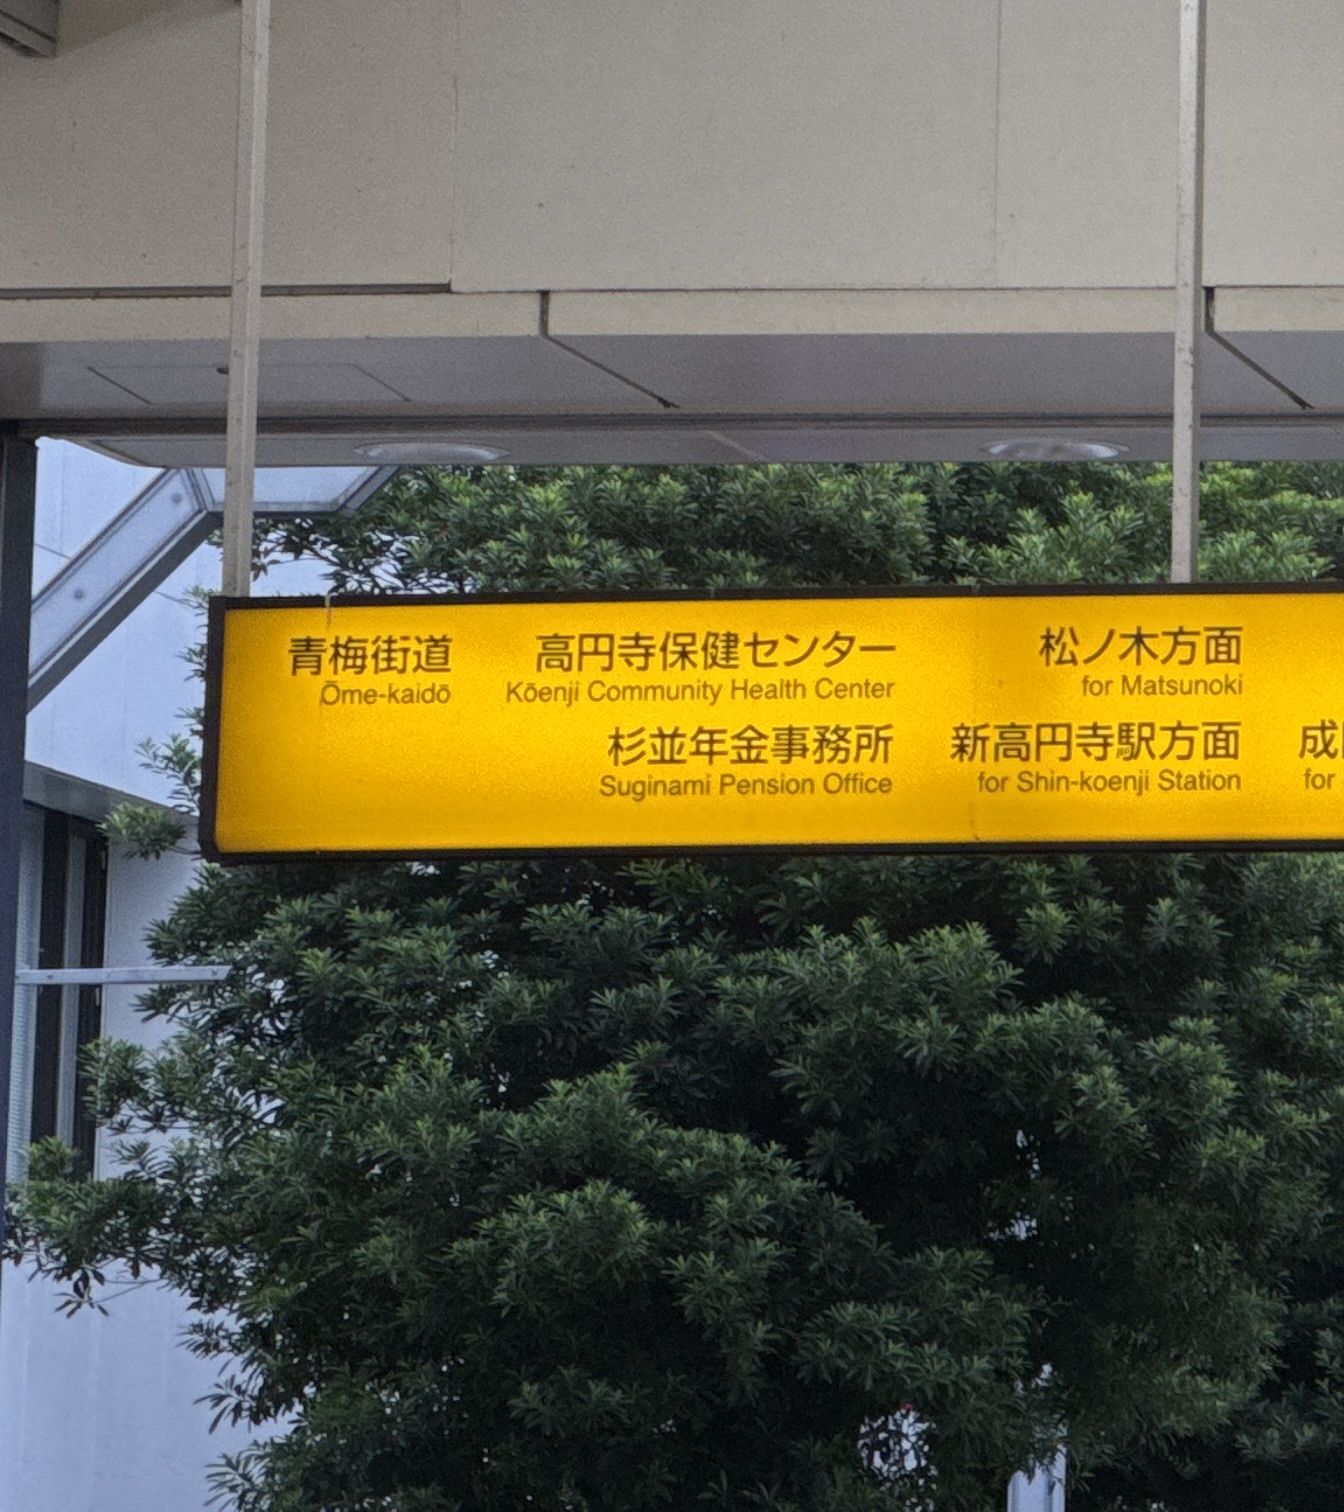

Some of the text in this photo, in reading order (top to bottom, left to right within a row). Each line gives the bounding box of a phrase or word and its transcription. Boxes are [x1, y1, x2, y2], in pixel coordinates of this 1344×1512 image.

[289, 635, 452, 676] 青梅街道
[537, 631, 895, 672] 高円寺保健センター
[1039, 626, 1242, 666] 松ノ木方面
[318, 680, 451, 706] Ōme-kaidō
[507, 677, 895, 707] Kōenji Community Health Center
[1082, 674, 1242, 696] for Matsunoki
[609, 725, 892, 765] 杉並年金事務所
[951, 721, 1240, 762] 新高円寺駅方面
[599, 772, 892, 803] Suginami Pension Office
[978, 769, 1241, 796] for Shin-koenji Station
[1304, 768, 1335, 790] for
